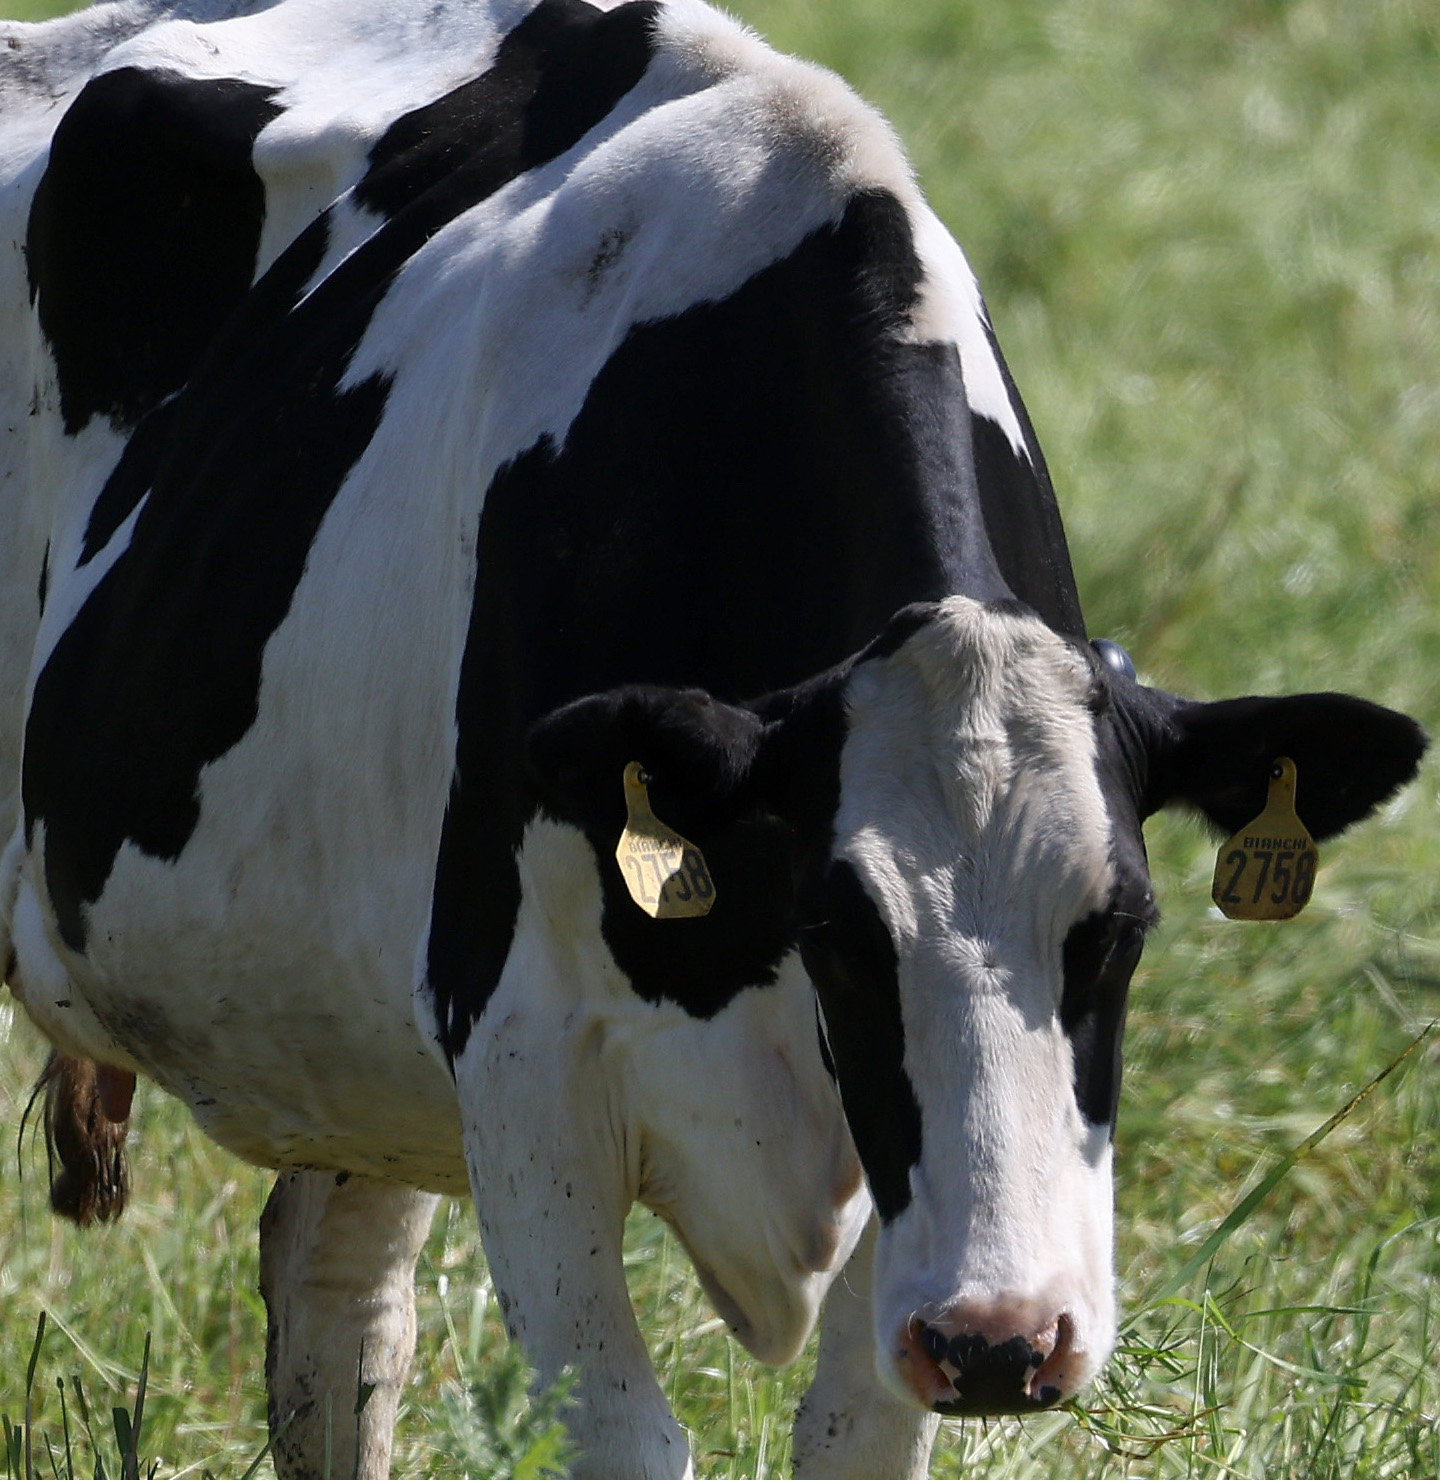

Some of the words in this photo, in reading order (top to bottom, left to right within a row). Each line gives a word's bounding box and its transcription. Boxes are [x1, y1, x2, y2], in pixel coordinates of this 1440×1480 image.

[1243, 836, 1307, 850] BIANCHI
[625, 849, 713, 904] 2758
[1221, 850, 1317, 905] 2758
